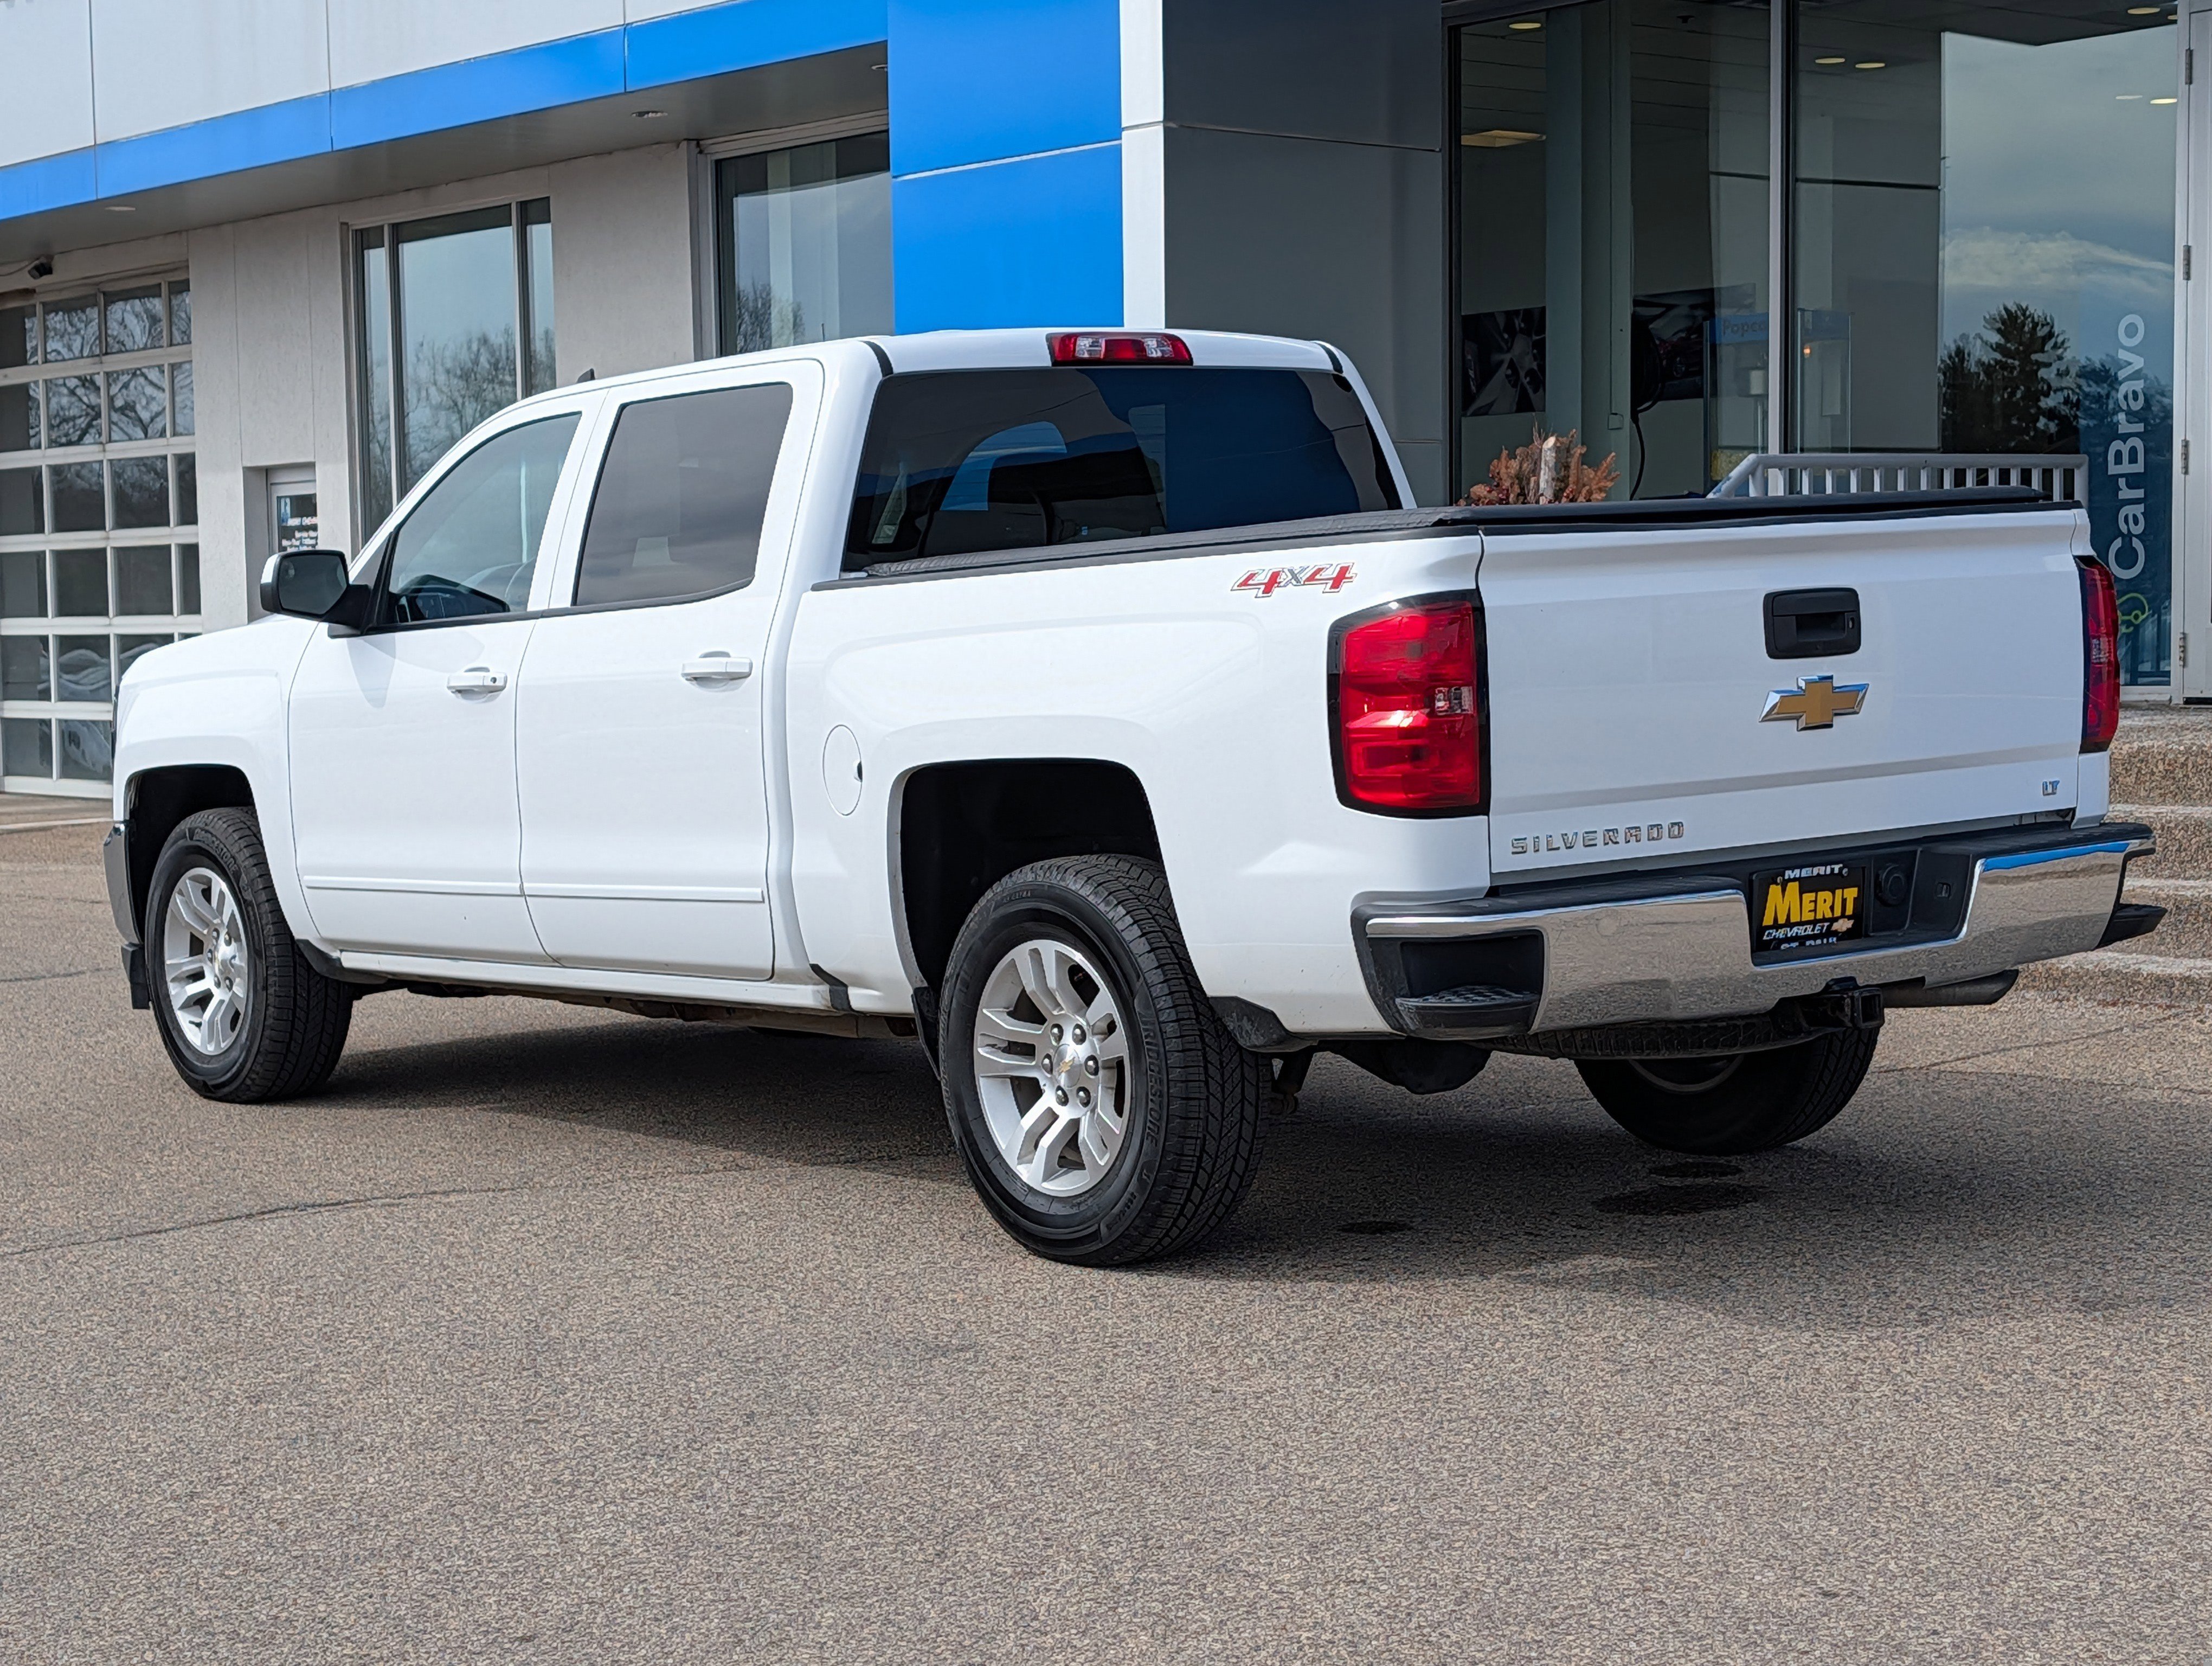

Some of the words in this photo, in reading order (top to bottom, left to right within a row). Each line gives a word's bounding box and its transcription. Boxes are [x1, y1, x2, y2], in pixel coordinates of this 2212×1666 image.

[2107, 313, 2146, 580] CarBravo
[2042, 780, 2060, 797] LT
[1510, 821, 1684, 855] SILVERADO
[1784, 863, 1843, 880] MERIT
[1762, 922, 1831, 940] CHEVROLET
